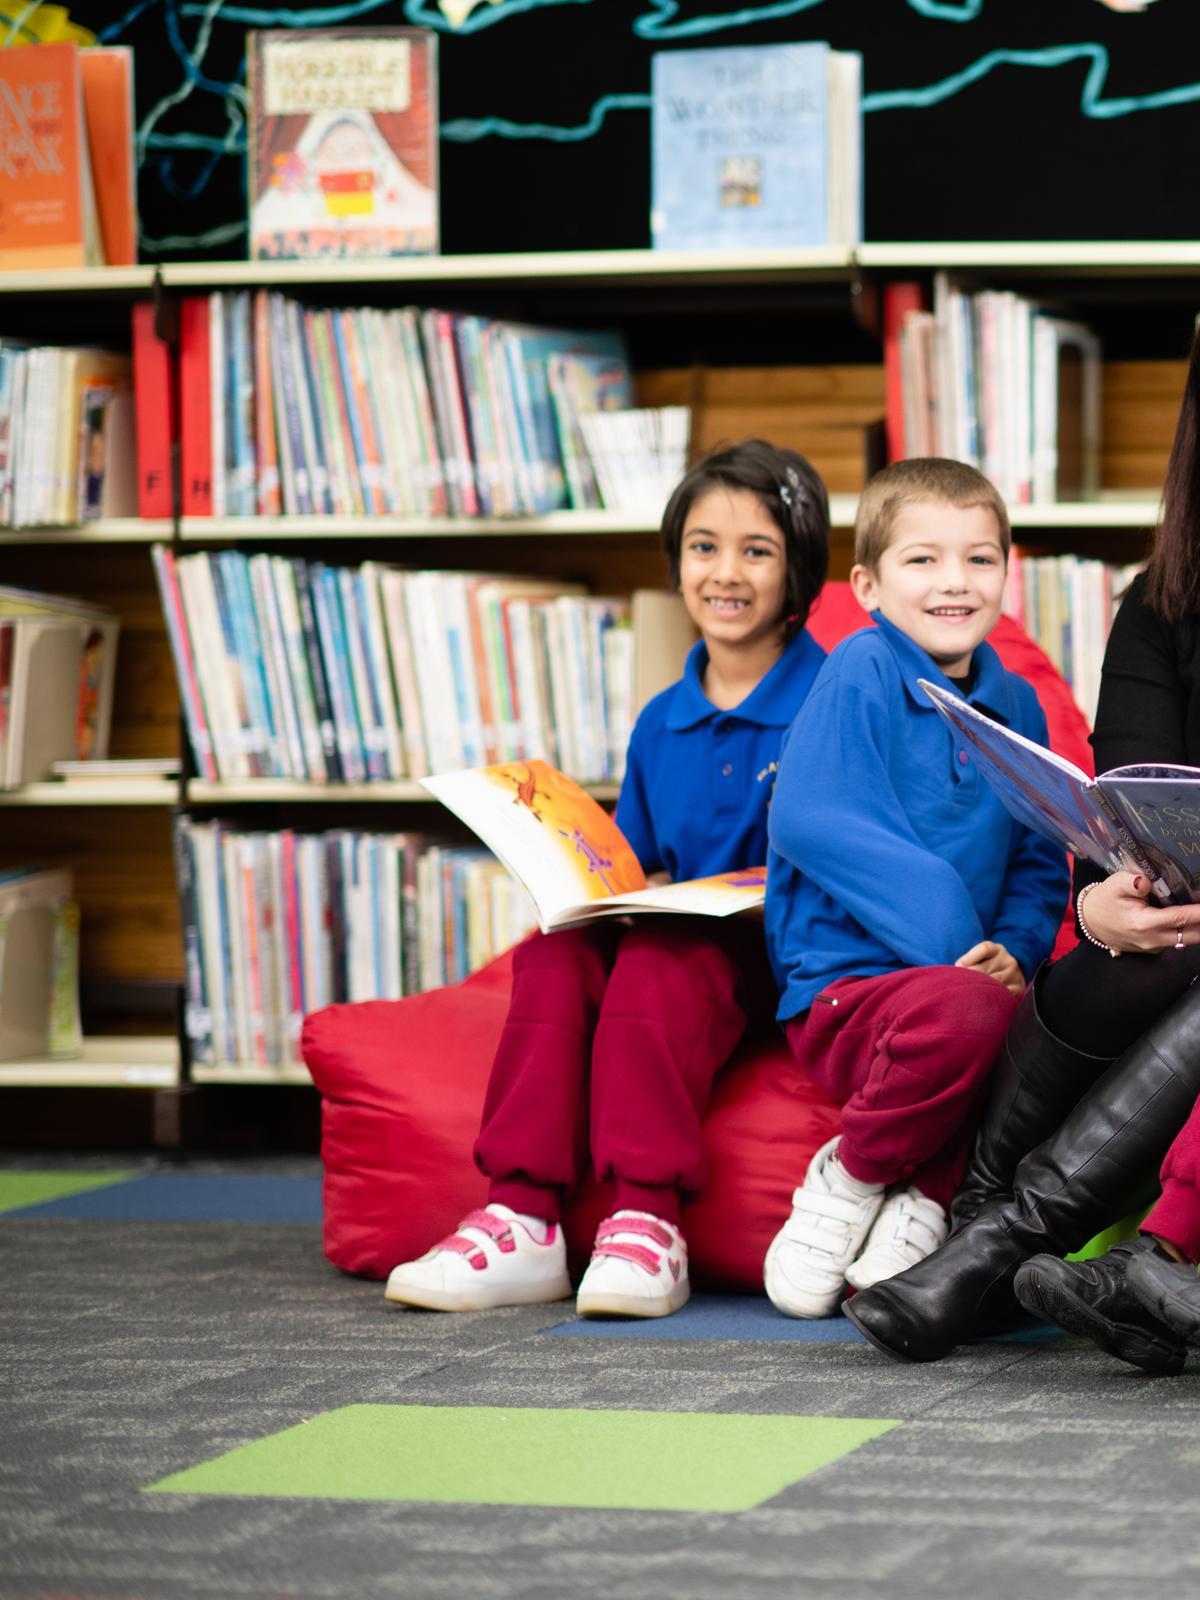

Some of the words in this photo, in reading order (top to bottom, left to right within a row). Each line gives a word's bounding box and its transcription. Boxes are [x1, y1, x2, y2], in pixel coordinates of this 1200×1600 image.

[1161, 826, 1177, 837] by
[1117, 826, 1137, 850] KISSED
[1139, 859, 1157, 880] MOON
